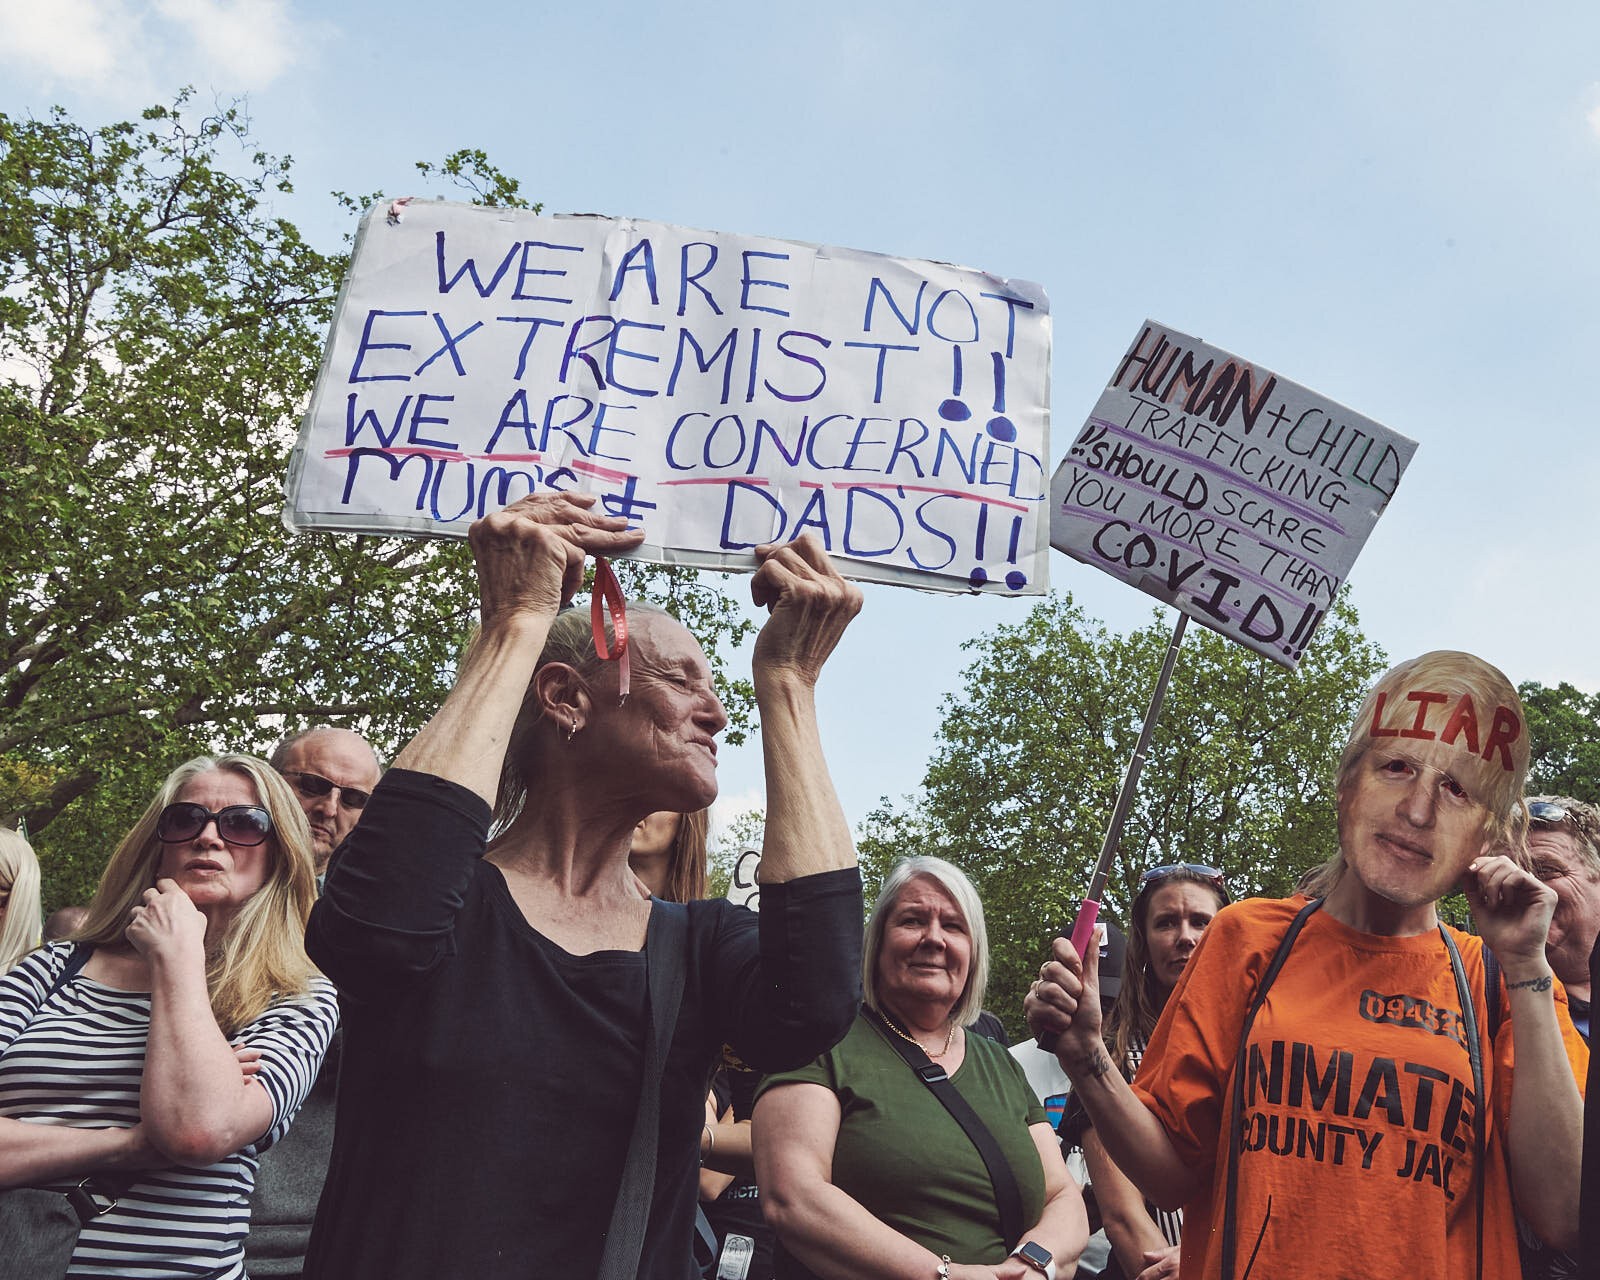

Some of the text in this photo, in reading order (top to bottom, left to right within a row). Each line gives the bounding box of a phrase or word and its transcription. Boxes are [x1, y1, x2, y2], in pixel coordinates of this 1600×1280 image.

[436, 231, 1034, 358] WE ARE NOT
[345, 388, 1045, 501] WE ARE CONCERNED
[1130, 395, 1350, 513] TRAFFICKING
[1285, 408, 1400, 498] CHILD
[1064, 467, 1339, 606] YOU MORE THAN
[1213, 489, 1326, 554] SCARE
[1369, 690, 1521, 772] LIAR
[1241, 1040, 1475, 1154] NMATE
